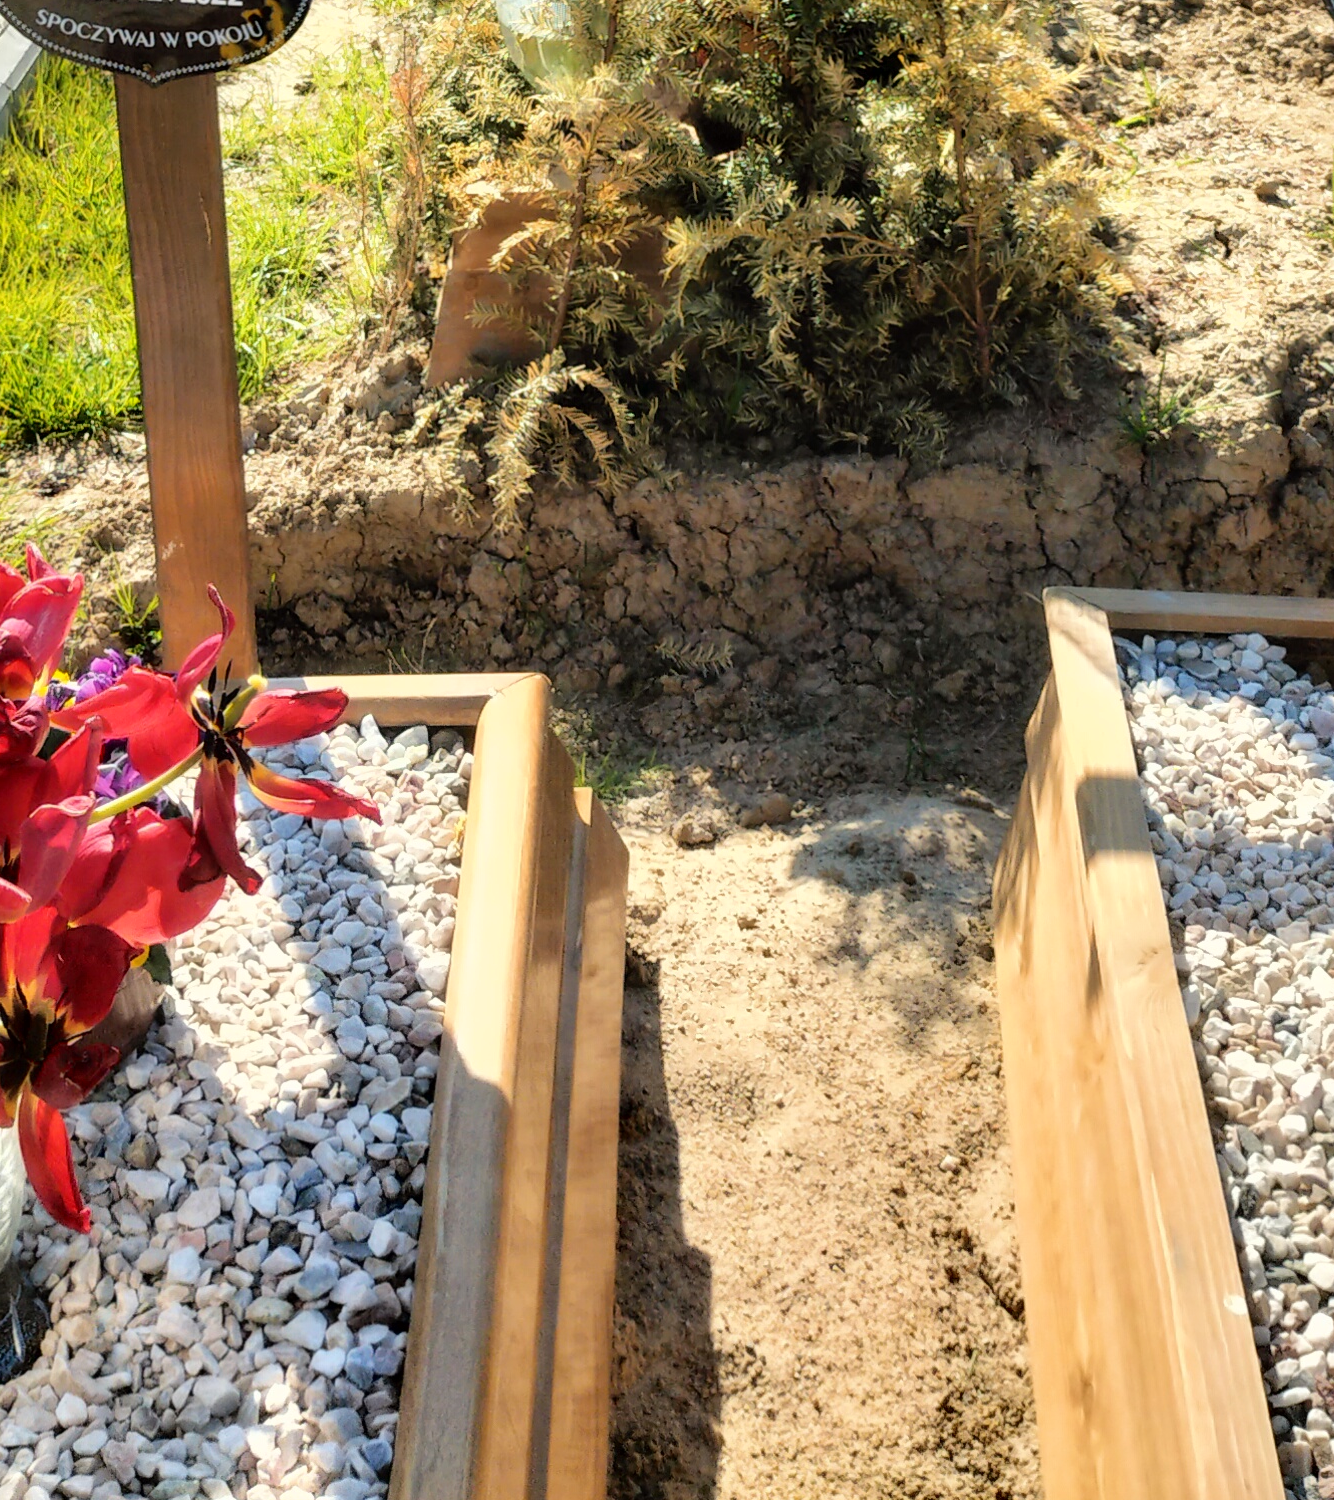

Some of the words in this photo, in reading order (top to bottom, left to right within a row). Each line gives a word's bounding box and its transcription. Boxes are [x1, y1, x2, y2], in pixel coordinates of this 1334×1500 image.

[35, 8, 155, 48] SPOCZYWAJ
[160, 31, 181, 49] W
[185, 20, 264, 48] POKOJU
